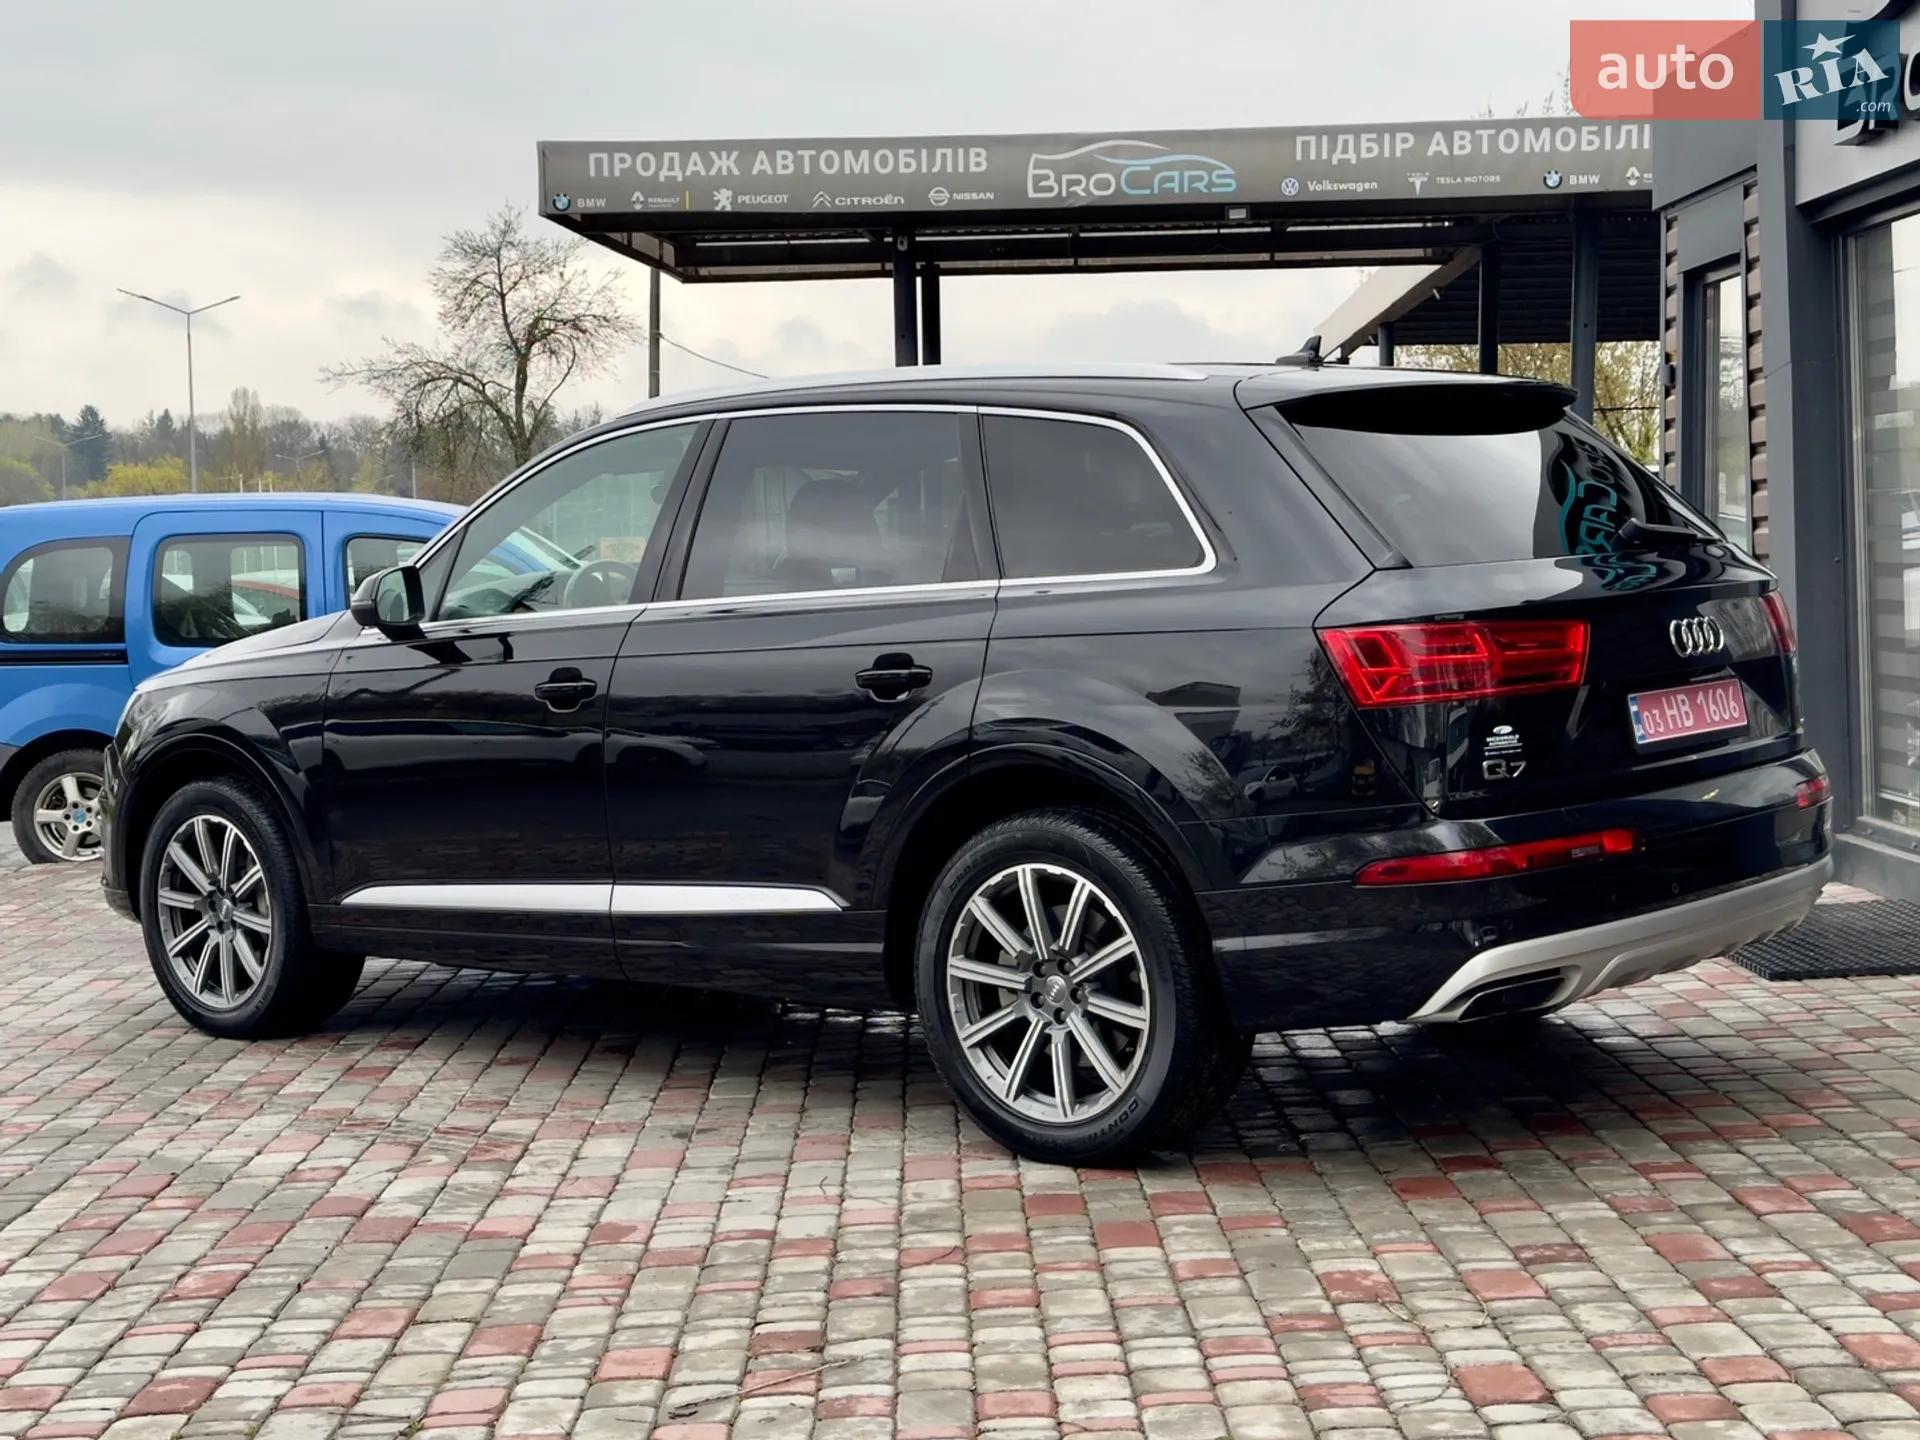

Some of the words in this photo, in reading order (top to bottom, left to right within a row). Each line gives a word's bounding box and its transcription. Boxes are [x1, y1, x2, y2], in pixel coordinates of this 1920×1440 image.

[1295, 131, 1415, 165] ПІДБІР
[588, 149, 740, 182] ПРОДАЖ
[751, 146, 989, 175] АВТОМОБІЛІВ
[1436, 176, 1462, 184] TESLA
[1464, 174, 1501, 183] MOTORS
[1569, 173, 1600, 185] BMW
[1307, 180, 1378, 192] Volkswagen
[738, 194, 789, 204] PEUGEOT
[953, 191, 995, 201] NISSAN
[577, 197, 607, 208] BMW
[1643, 709, 1664, 735] 03
[1697, 686, 1740, 724] 1606
[1482, 758, 1527, 780] Q7
